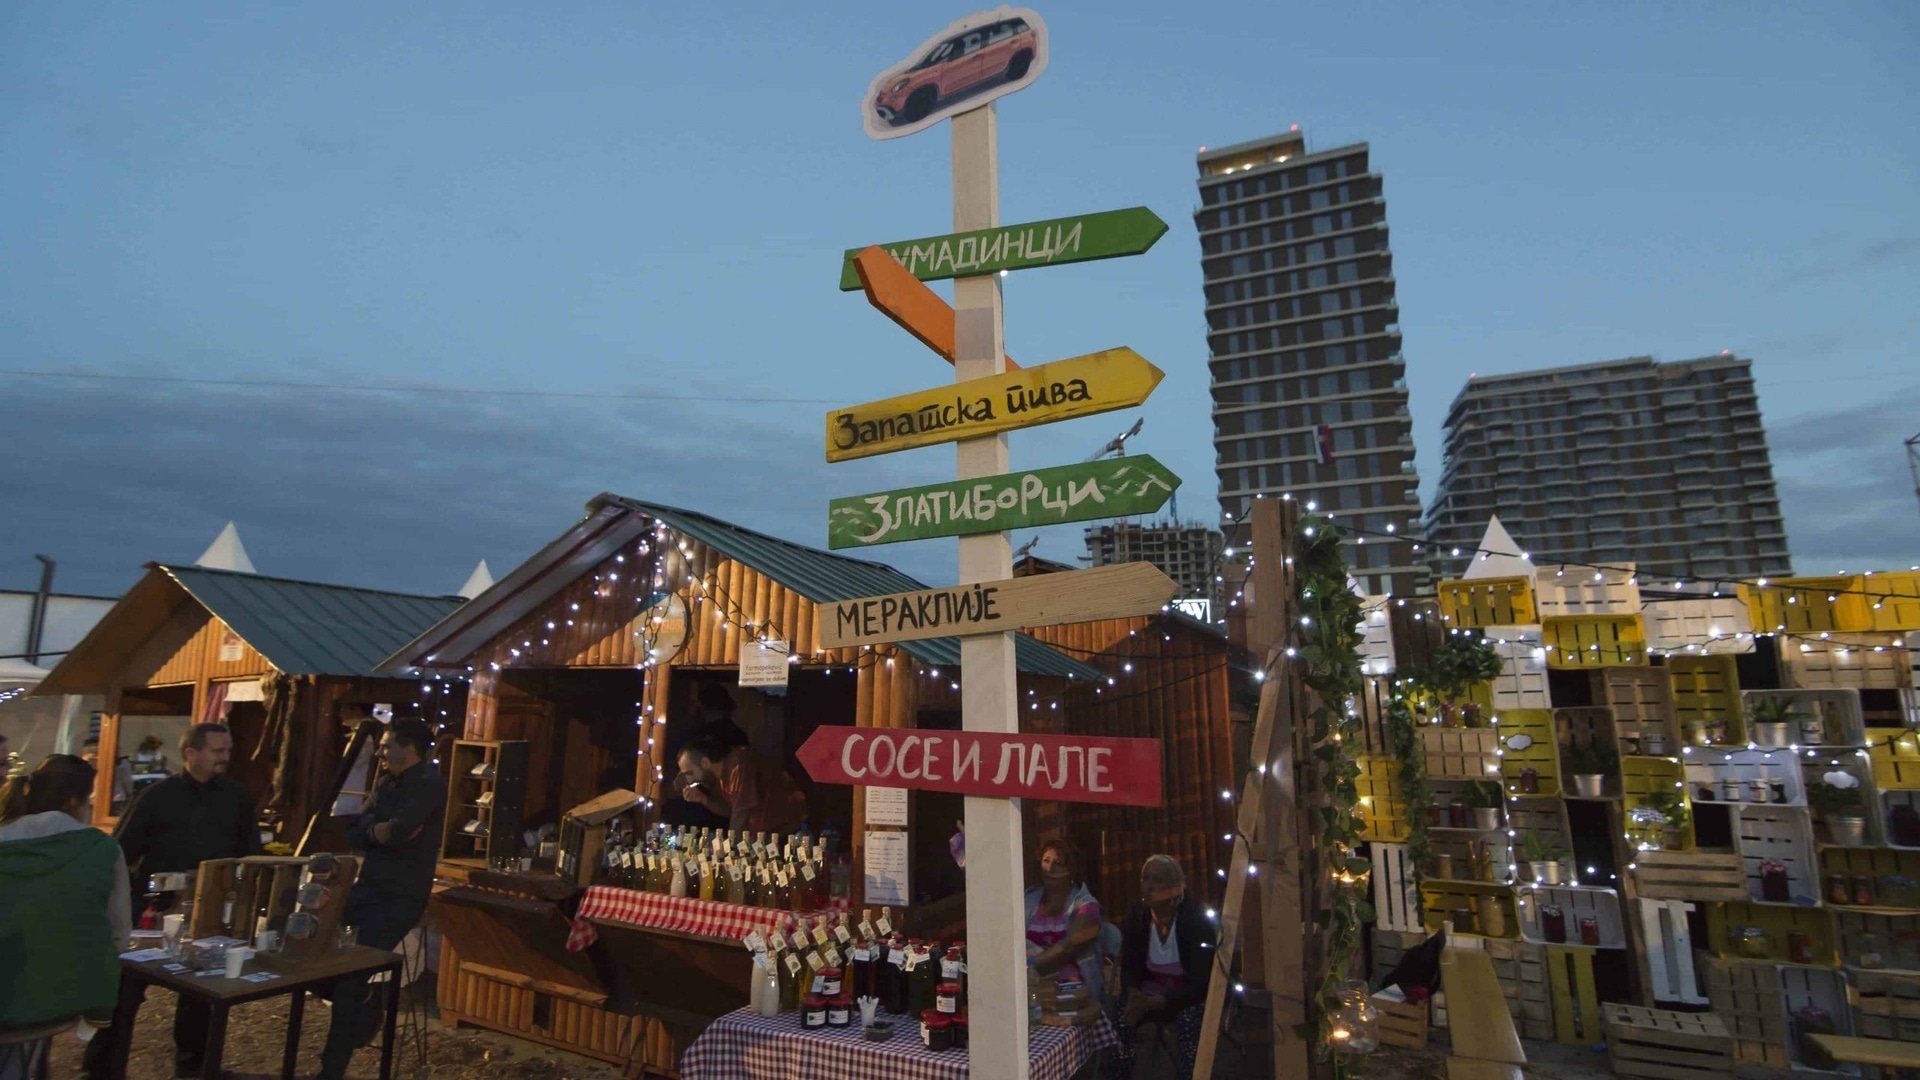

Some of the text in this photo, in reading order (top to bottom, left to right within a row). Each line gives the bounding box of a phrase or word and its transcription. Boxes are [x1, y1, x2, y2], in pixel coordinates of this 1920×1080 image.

[886, 221, 1083, 274] УМАДИНЦИ
[850, 474, 1106, 543] ЗЛАТИБОРЦИ
[841, 733, 942, 780] СОСЕ
[952, 738, 980, 783] И
